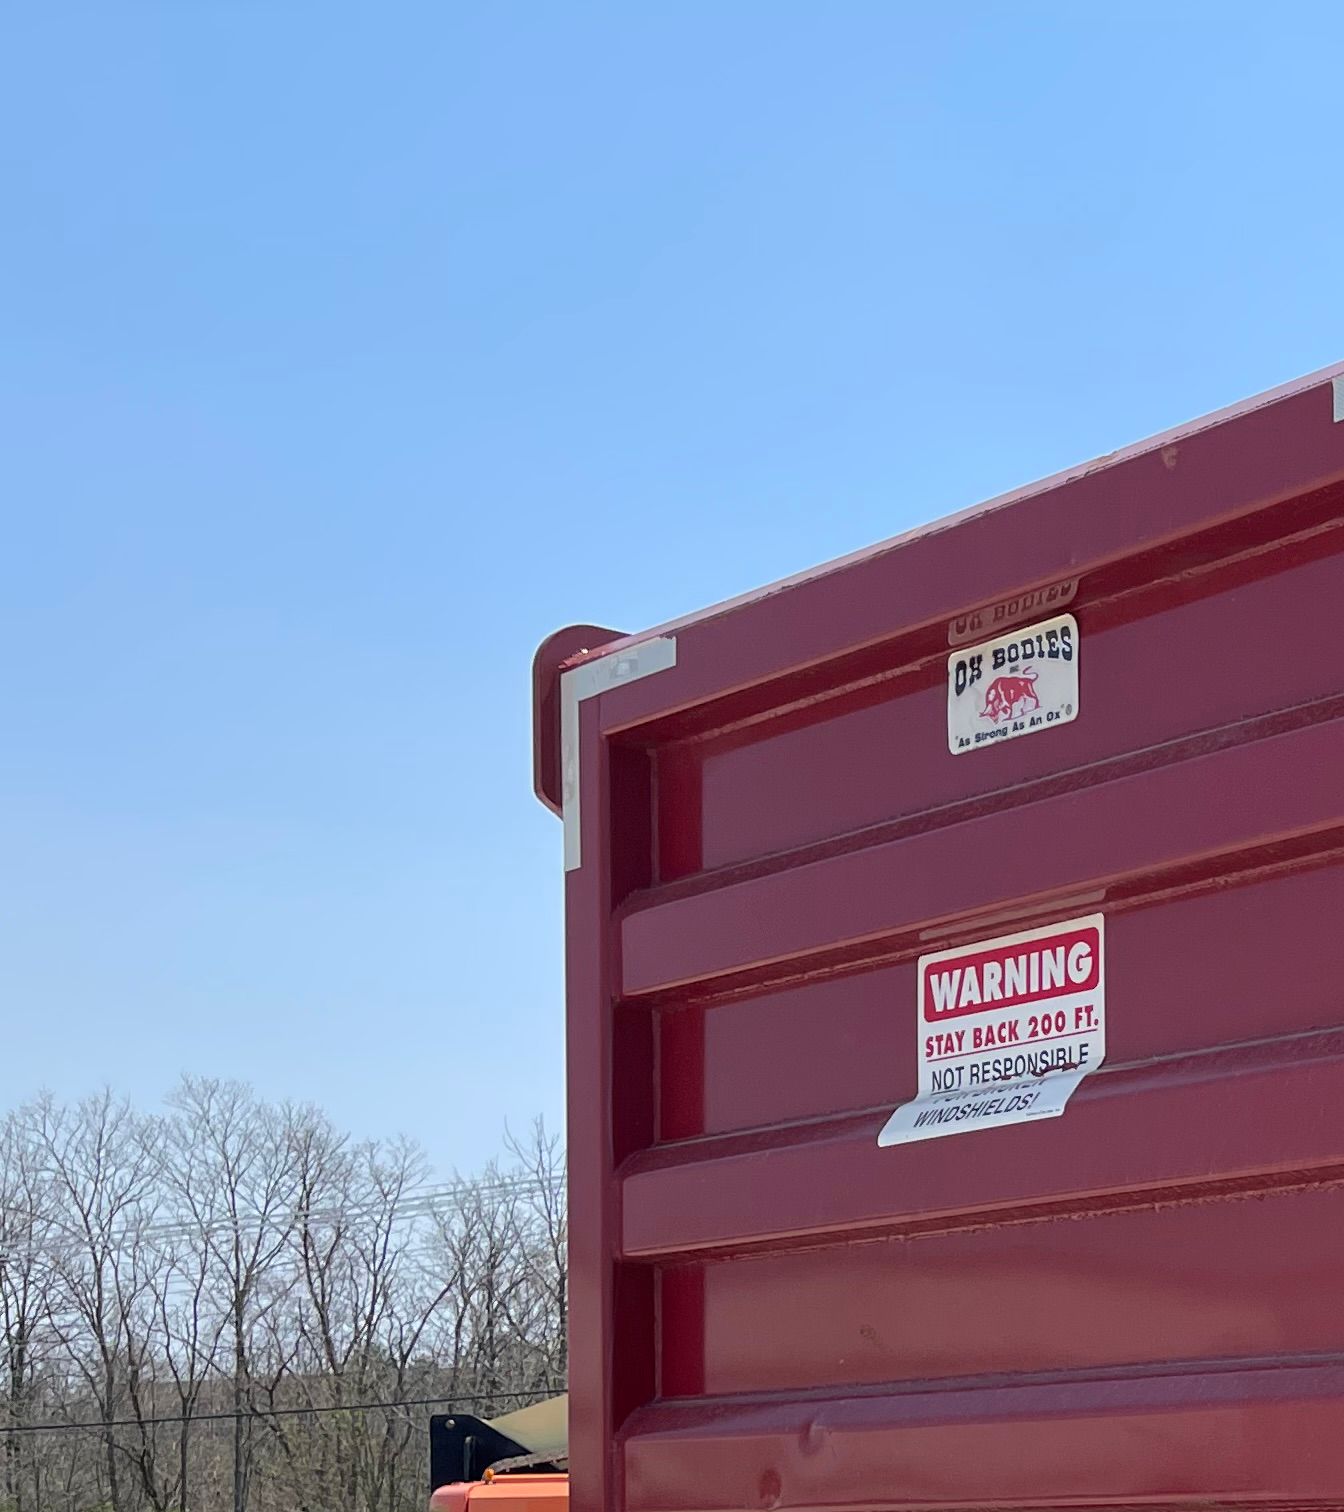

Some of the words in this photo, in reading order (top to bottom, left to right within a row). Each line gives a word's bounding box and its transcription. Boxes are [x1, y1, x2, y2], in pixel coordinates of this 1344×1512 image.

[955, 653, 984, 697] OX
[992, 625, 1073, 671] BODIES
[974, 722, 1008, 744] Strong
[1012, 719, 1025, 733] As
[1029, 715, 1043, 728] An
[930, 941, 1093, 1013] WARNING
[925, 1029, 966, 1058] STAY
[972, 1019, 1019, 1050] BACK
[1027, 1010, 1066, 1039] 200
[1074, 1004, 1099, 1030] FT.
[931, 1066, 965, 1093] NOT
[969, 1043, 1090, 1086] RESPONSIBLE
[913, 1091, 1041, 1128] WINDSHIELDS!
